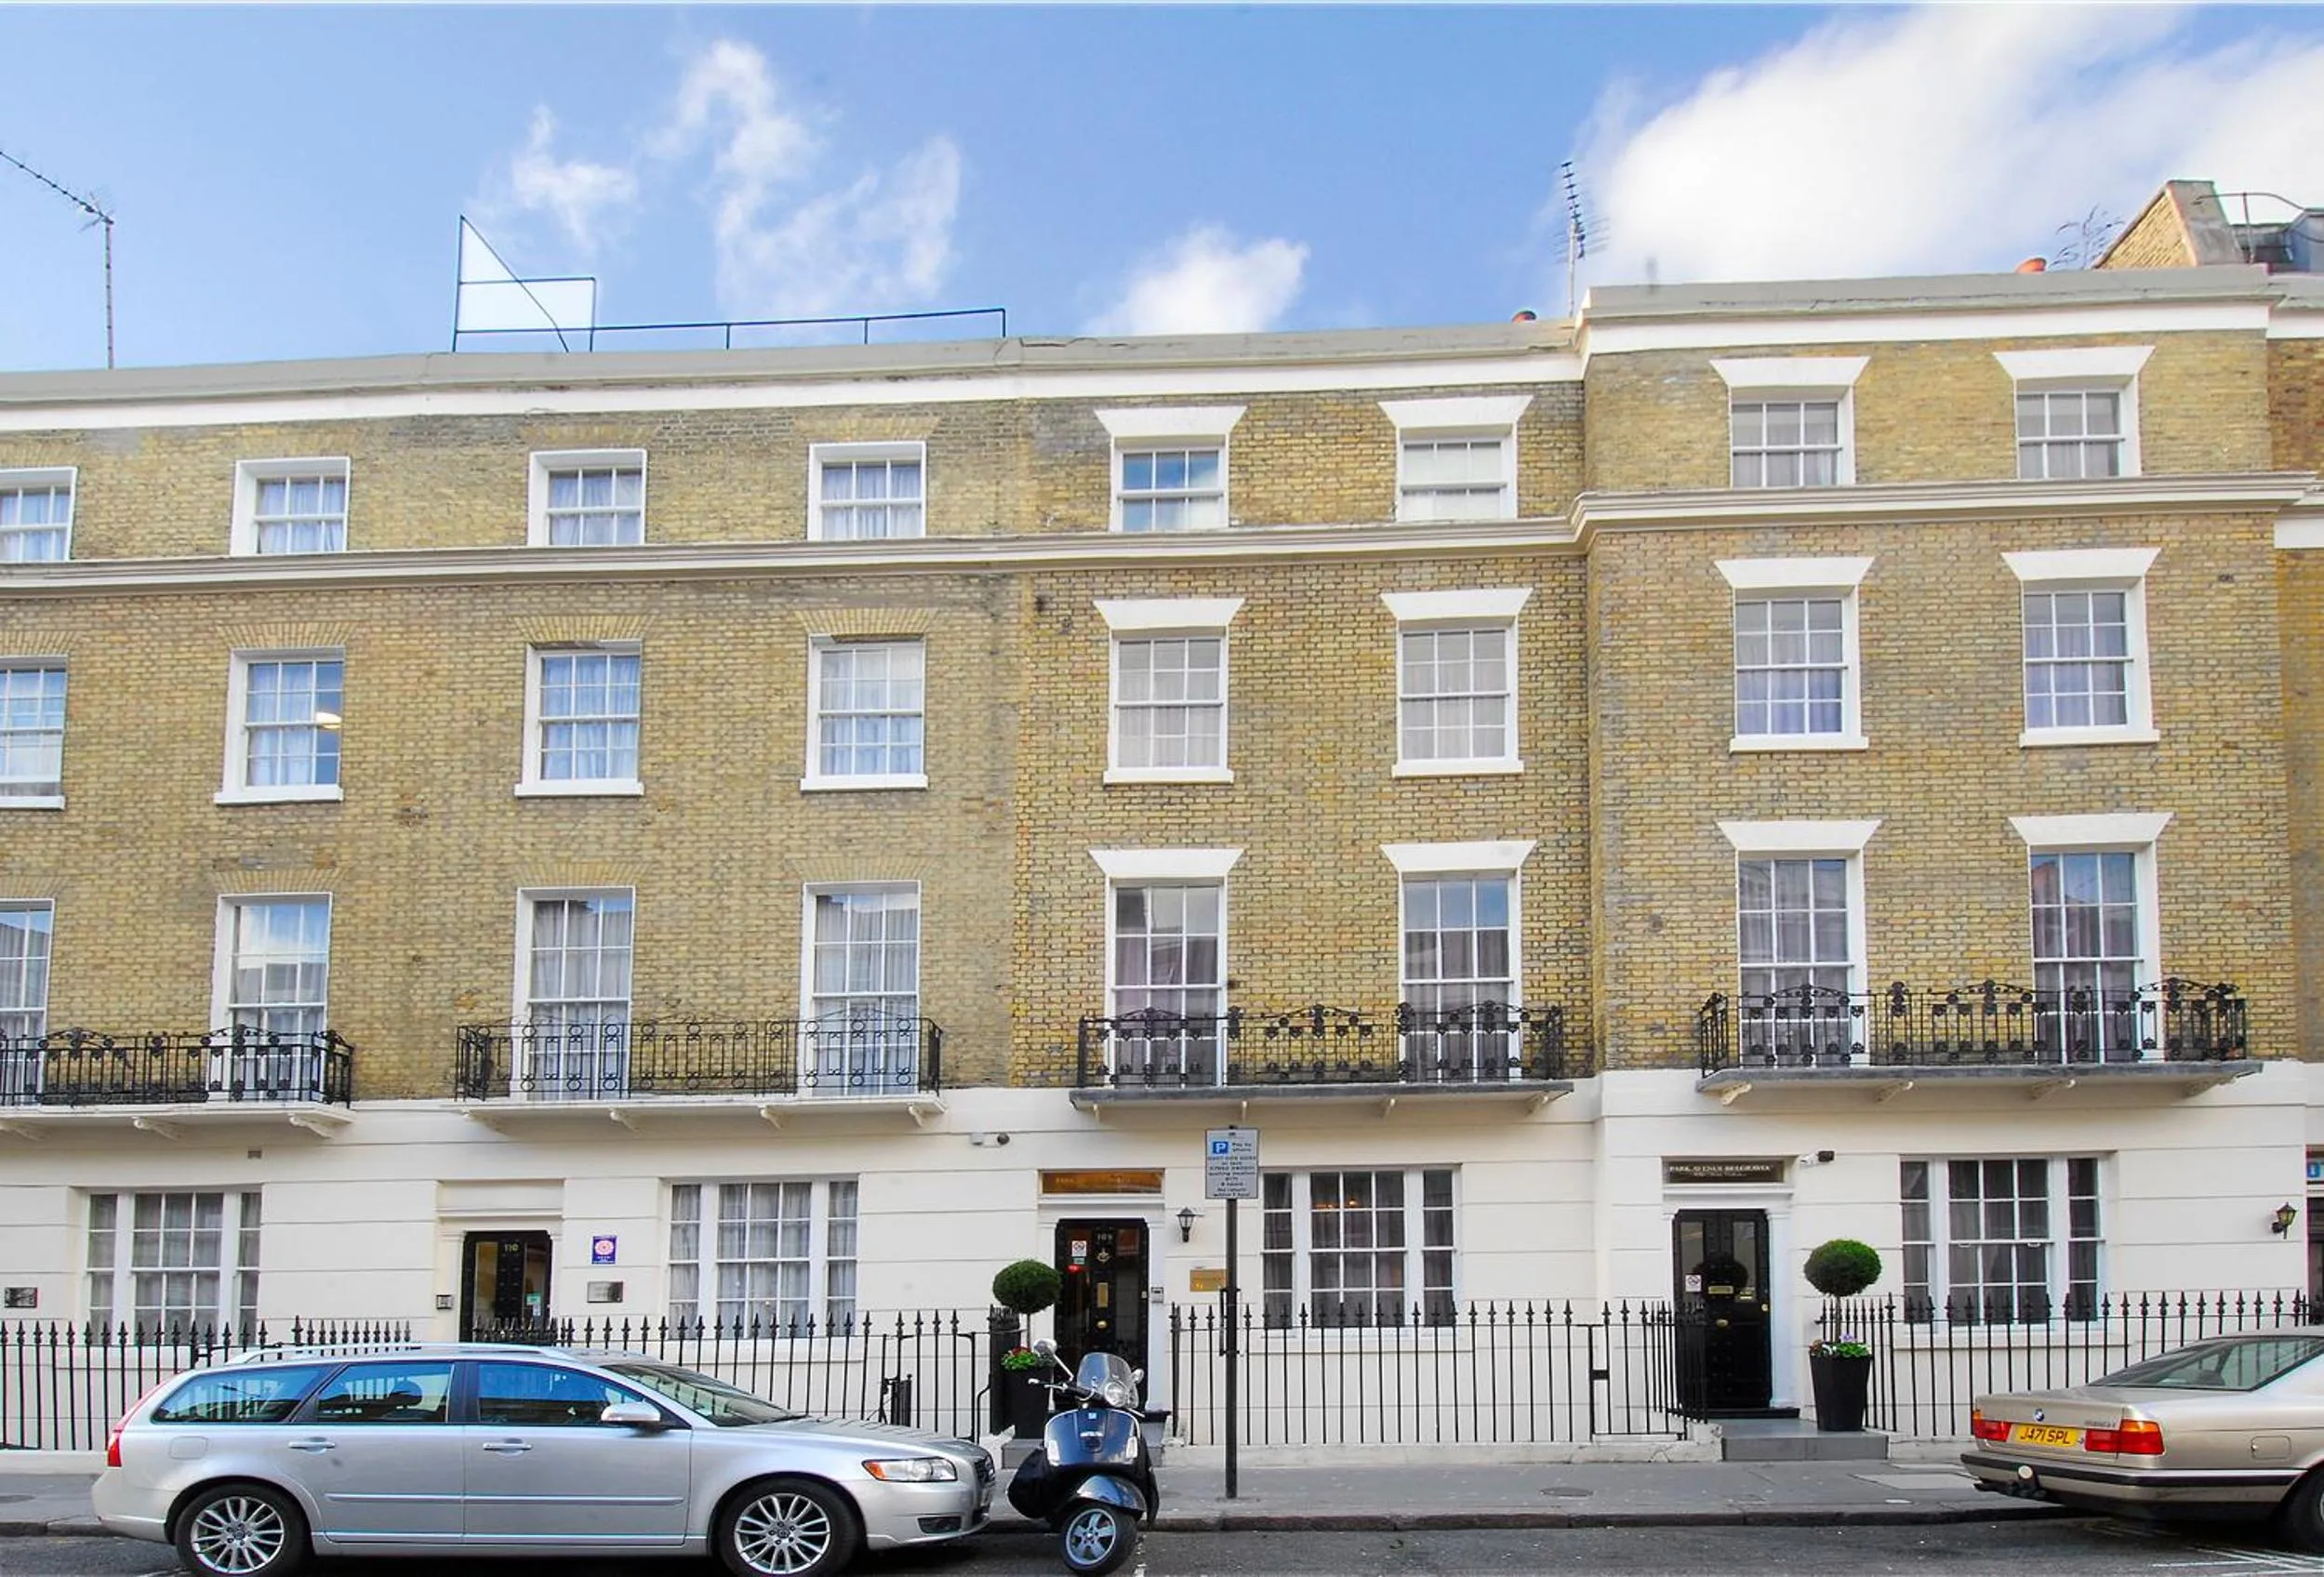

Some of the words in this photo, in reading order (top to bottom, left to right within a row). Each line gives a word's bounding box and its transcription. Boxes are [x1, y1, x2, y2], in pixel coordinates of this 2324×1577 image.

[504, 1243, 519, 1252] 110
[2020, 1427, 2046, 1442] J471
[2046, 1429, 2070, 1445] SPL
